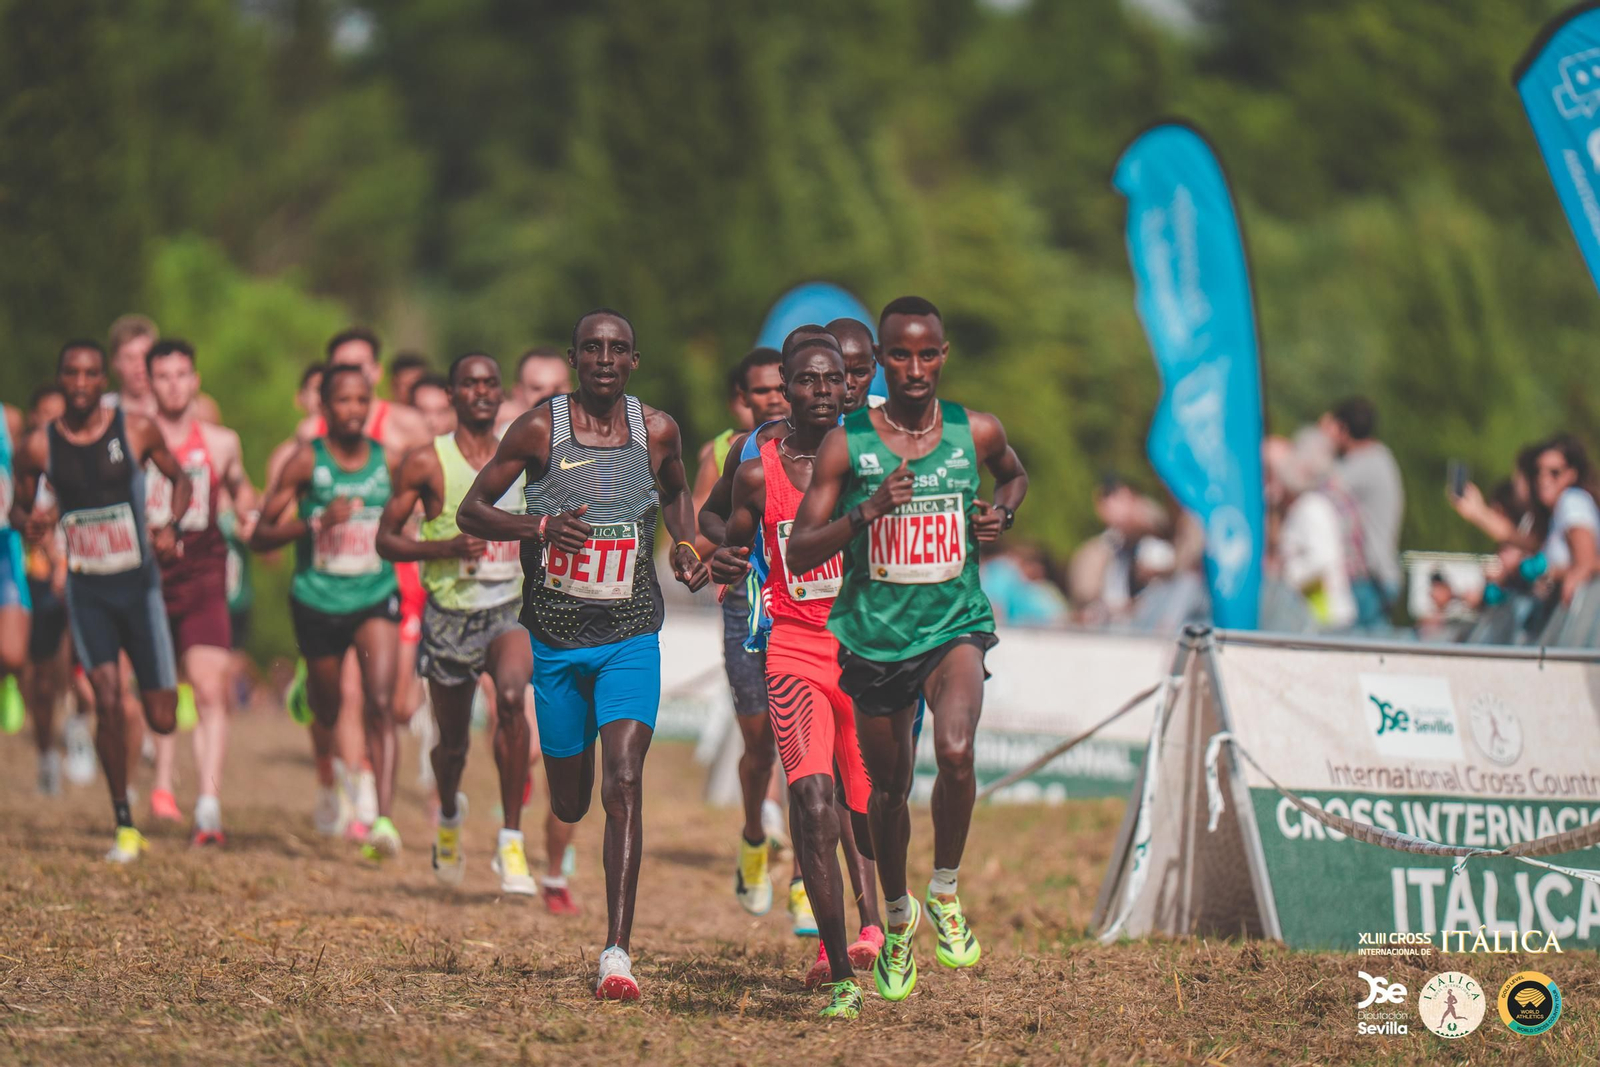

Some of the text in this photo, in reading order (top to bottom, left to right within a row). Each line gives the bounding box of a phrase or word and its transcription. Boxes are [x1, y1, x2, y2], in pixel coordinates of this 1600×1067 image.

[593, 527, 617, 538] LICA
[871, 513, 962, 566] KWIZERA
[547, 538, 636, 584] BETT
[1326, 758, 1464, 793] International
[1466, 765, 1527, 795] Cross
[1276, 796, 1398, 841] CROSS
